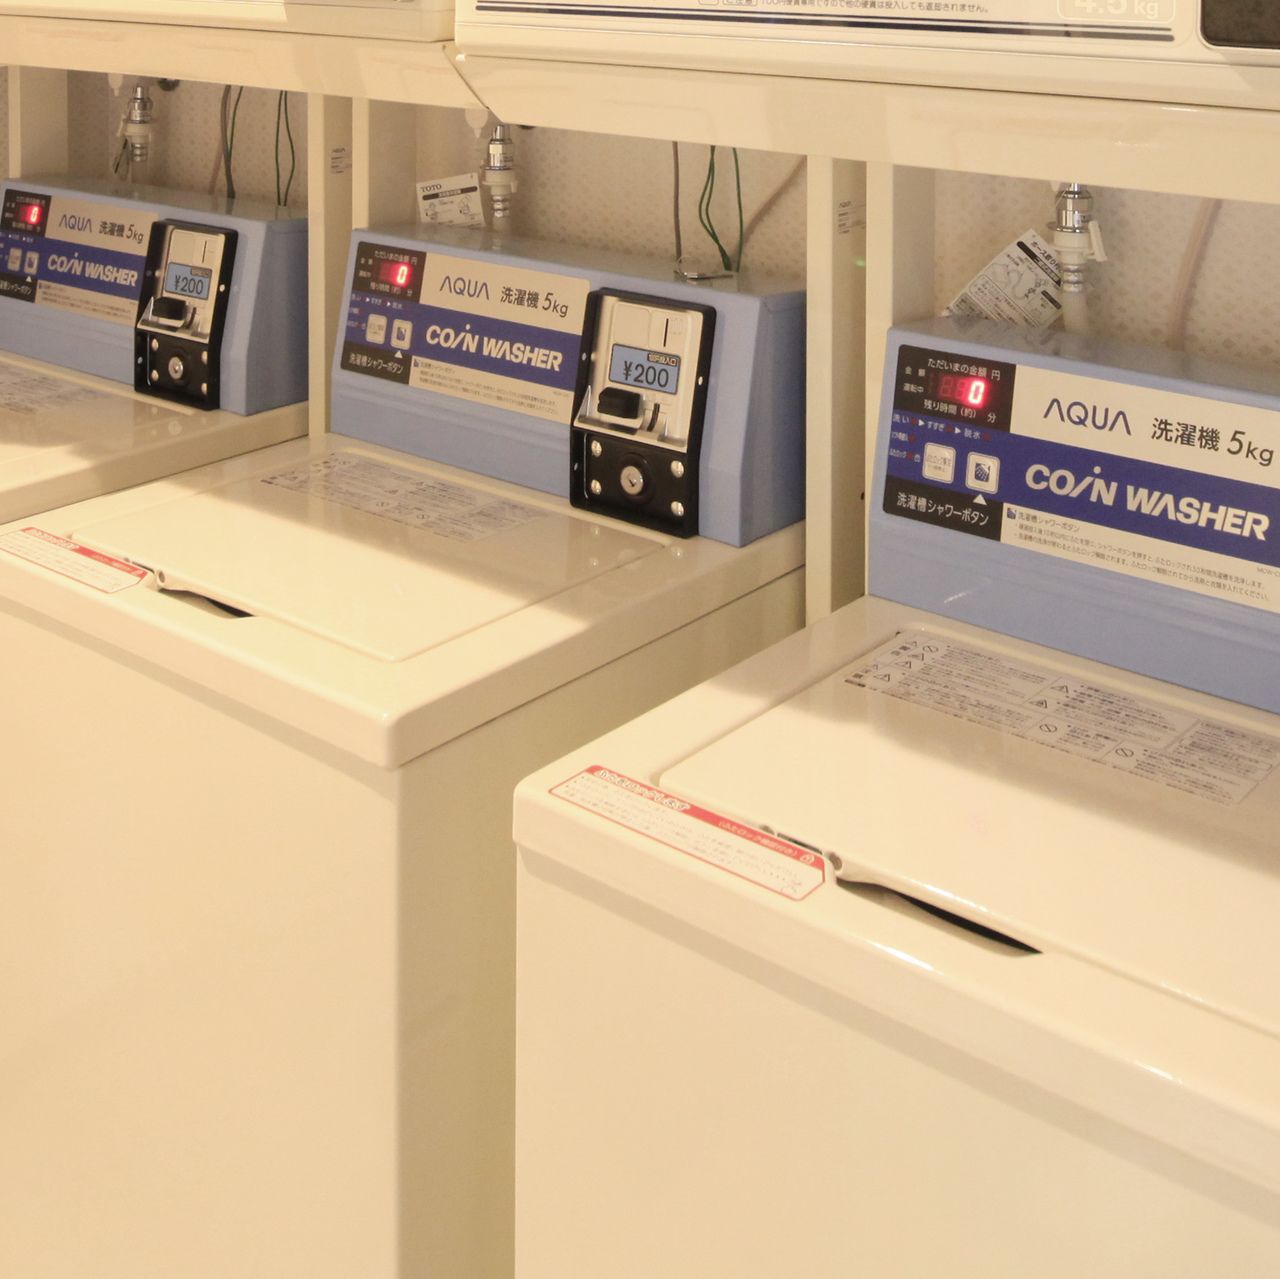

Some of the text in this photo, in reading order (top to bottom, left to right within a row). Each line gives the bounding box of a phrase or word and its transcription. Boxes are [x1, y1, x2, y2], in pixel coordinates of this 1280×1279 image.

[58, 213, 93, 234] AQUA
[126, 227, 144, 244] 5kg
[85, 258, 138, 288] WASHER
[175, 274, 204, 295] ¥200
[397, 265, 408, 284] 0
[439, 274, 570, 318] AQUA 洗濯機 5kg
[483, 337, 563, 372] WASHER
[927, 358, 1001, 381] ただいまの金額 円
[623, 360, 669, 388] ¥200
[967, 381, 985, 404] 0
[986, 412, 997, 424] 分
[1043, 397, 1275, 468] AQUA 洗濯機 5kg
[895, 491, 989, 526] 洗濯槽シャワーボタン
[1126, 484, 1271, 541] WASHER
